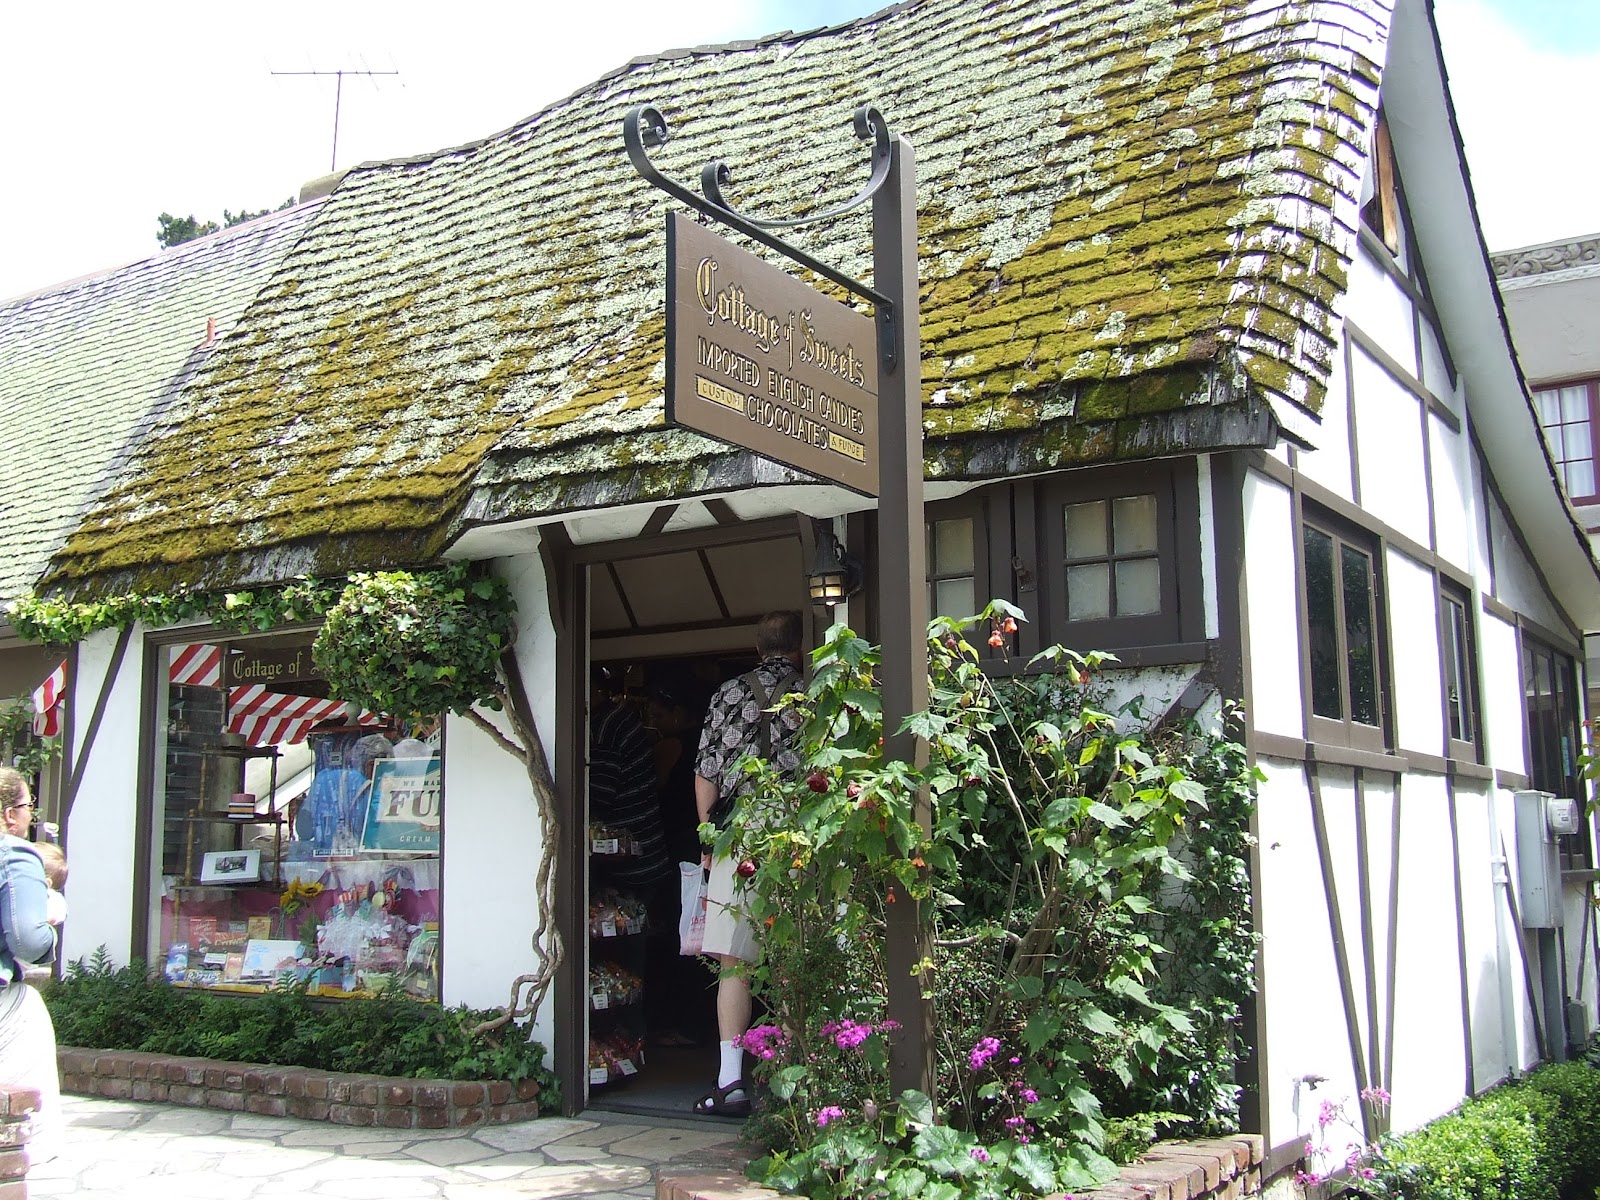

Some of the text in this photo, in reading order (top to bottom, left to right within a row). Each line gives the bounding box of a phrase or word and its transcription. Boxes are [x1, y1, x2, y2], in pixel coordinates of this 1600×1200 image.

[696, 256, 865, 387] Cottage of Sweets
[697, 336, 864, 435] IMPORTED ENGLISH CANDIES
[702, 382, 740, 406] CUSTOM
[746, 394, 828, 450] CHOCOLATES
[838, 438, 861, 457] FUDGE
[233, 651, 303, 680] Cottage of
